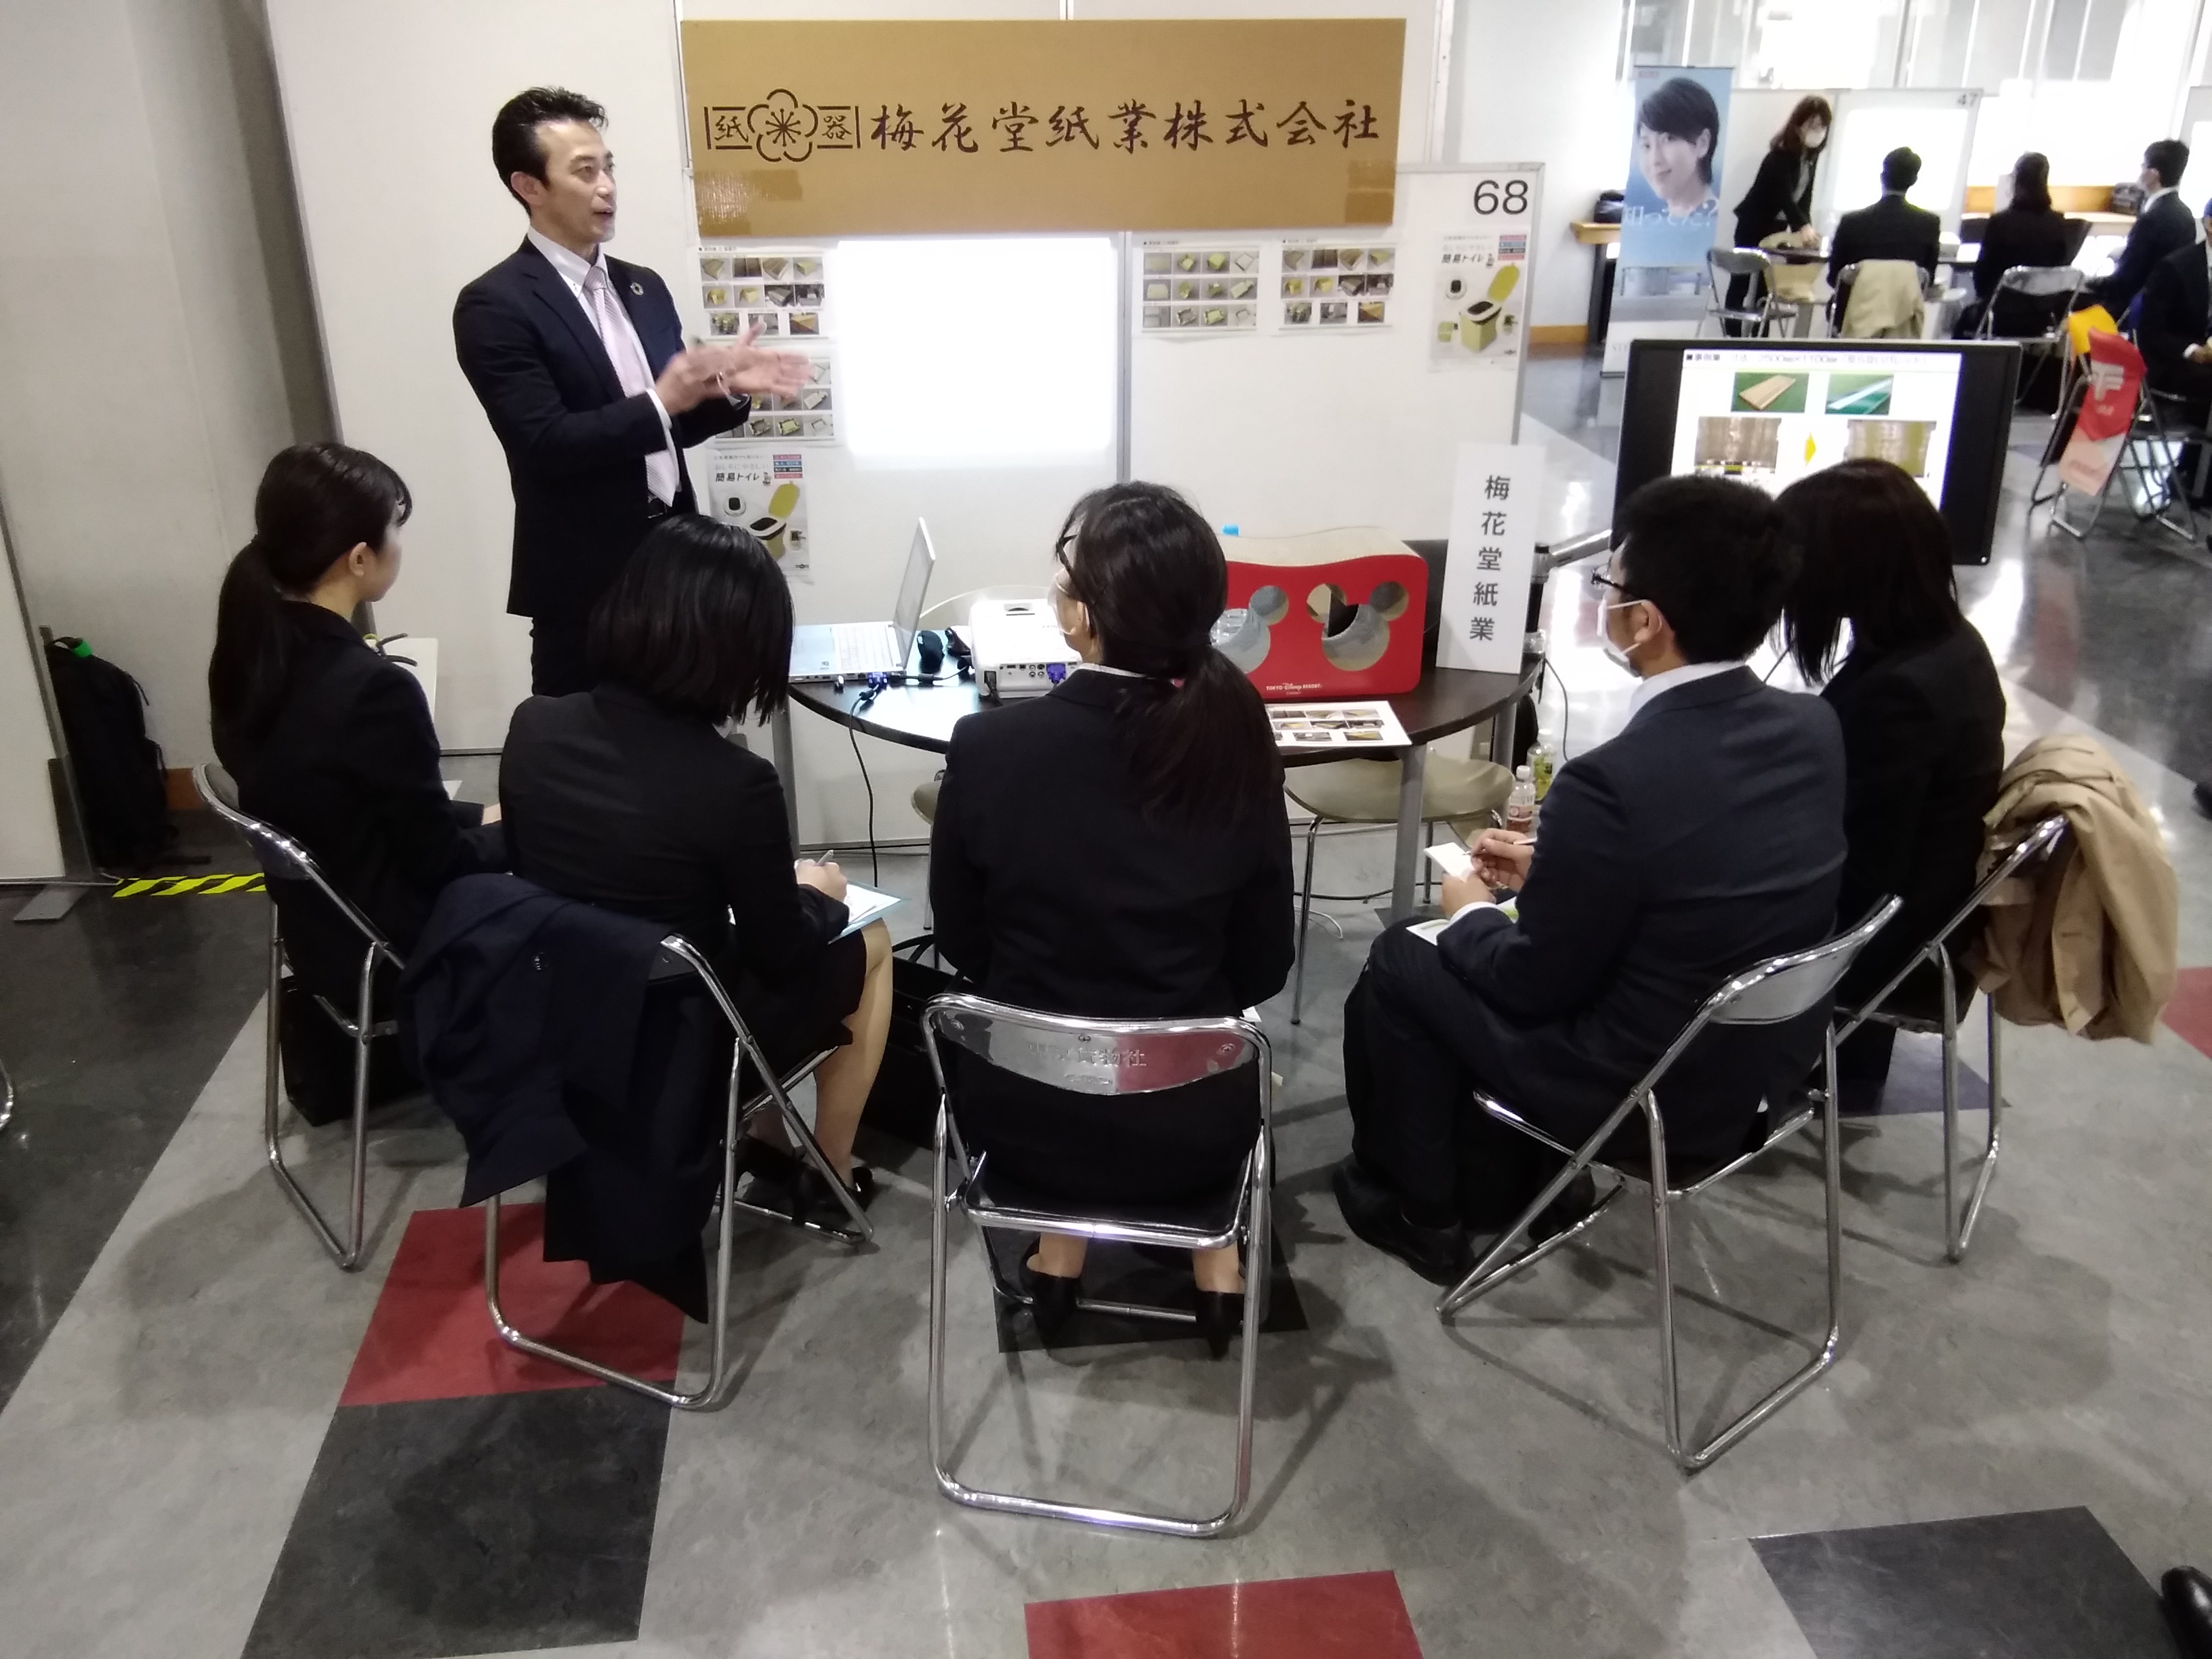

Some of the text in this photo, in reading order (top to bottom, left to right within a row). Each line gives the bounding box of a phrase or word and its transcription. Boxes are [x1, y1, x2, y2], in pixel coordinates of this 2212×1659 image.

[1957, 93, 1978, 108] 47
[714, 115, 853, 143] 紙 器
[870, 98, 1379, 155] 梅花堂紙業株式会社
[1473, 179, 1529, 216] 68
[715, 472, 760, 483] 簡易トイレ
[1469, 474, 1511, 641] 梅花堂紙業
